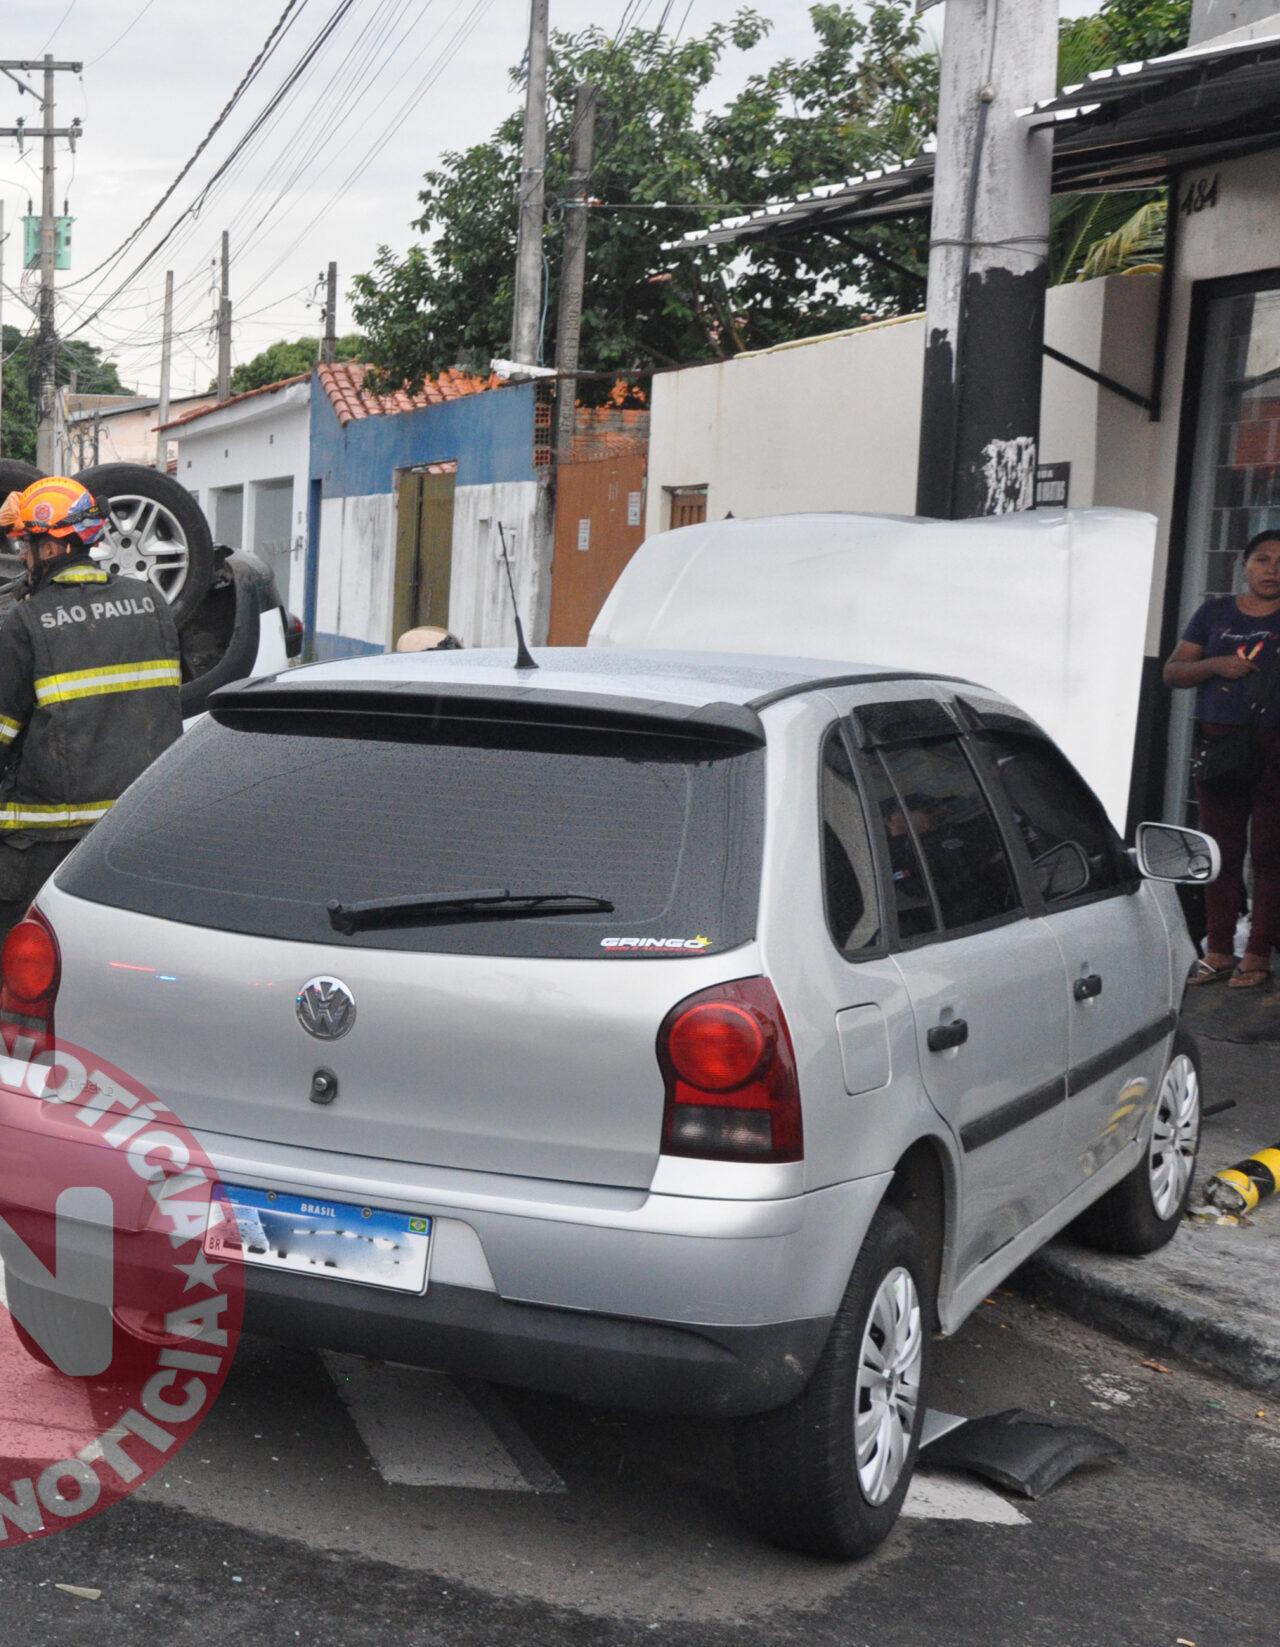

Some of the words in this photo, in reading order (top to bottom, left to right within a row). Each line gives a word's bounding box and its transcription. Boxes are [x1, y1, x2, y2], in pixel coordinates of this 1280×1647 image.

[40, 604, 87, 628] SÃO
[90, 596, 156, 620] PAULO
[600, 937, 705, 949] GRINGO
[301, 1202, 337, 1218] BRASIL
[208, 1236, 222, 1252] BR
